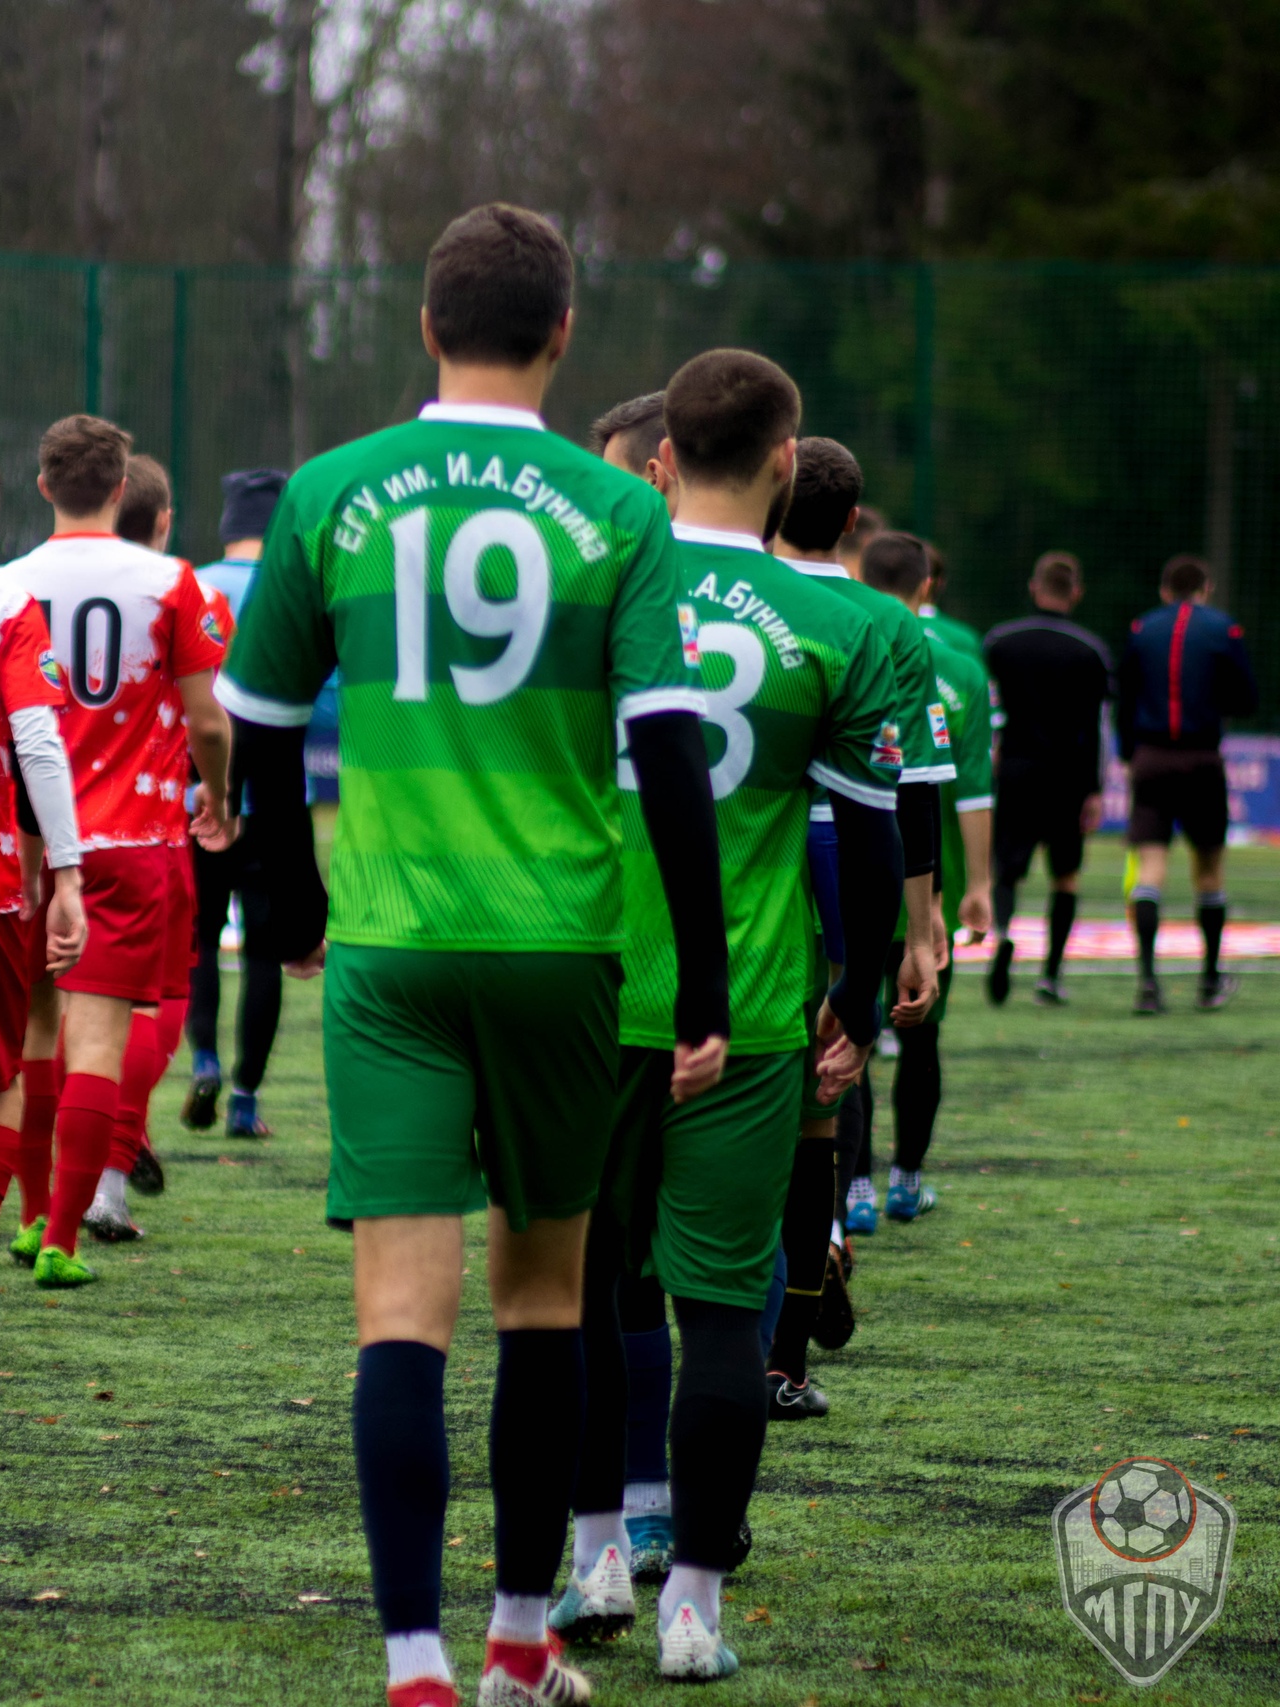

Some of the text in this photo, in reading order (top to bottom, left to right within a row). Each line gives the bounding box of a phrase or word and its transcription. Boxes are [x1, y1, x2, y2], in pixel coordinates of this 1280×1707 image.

[334, 485, 381, 553] ЕГУ
[389, 505, 552, 706] 19
[686, 571, 805, 670] .А.Бунина
